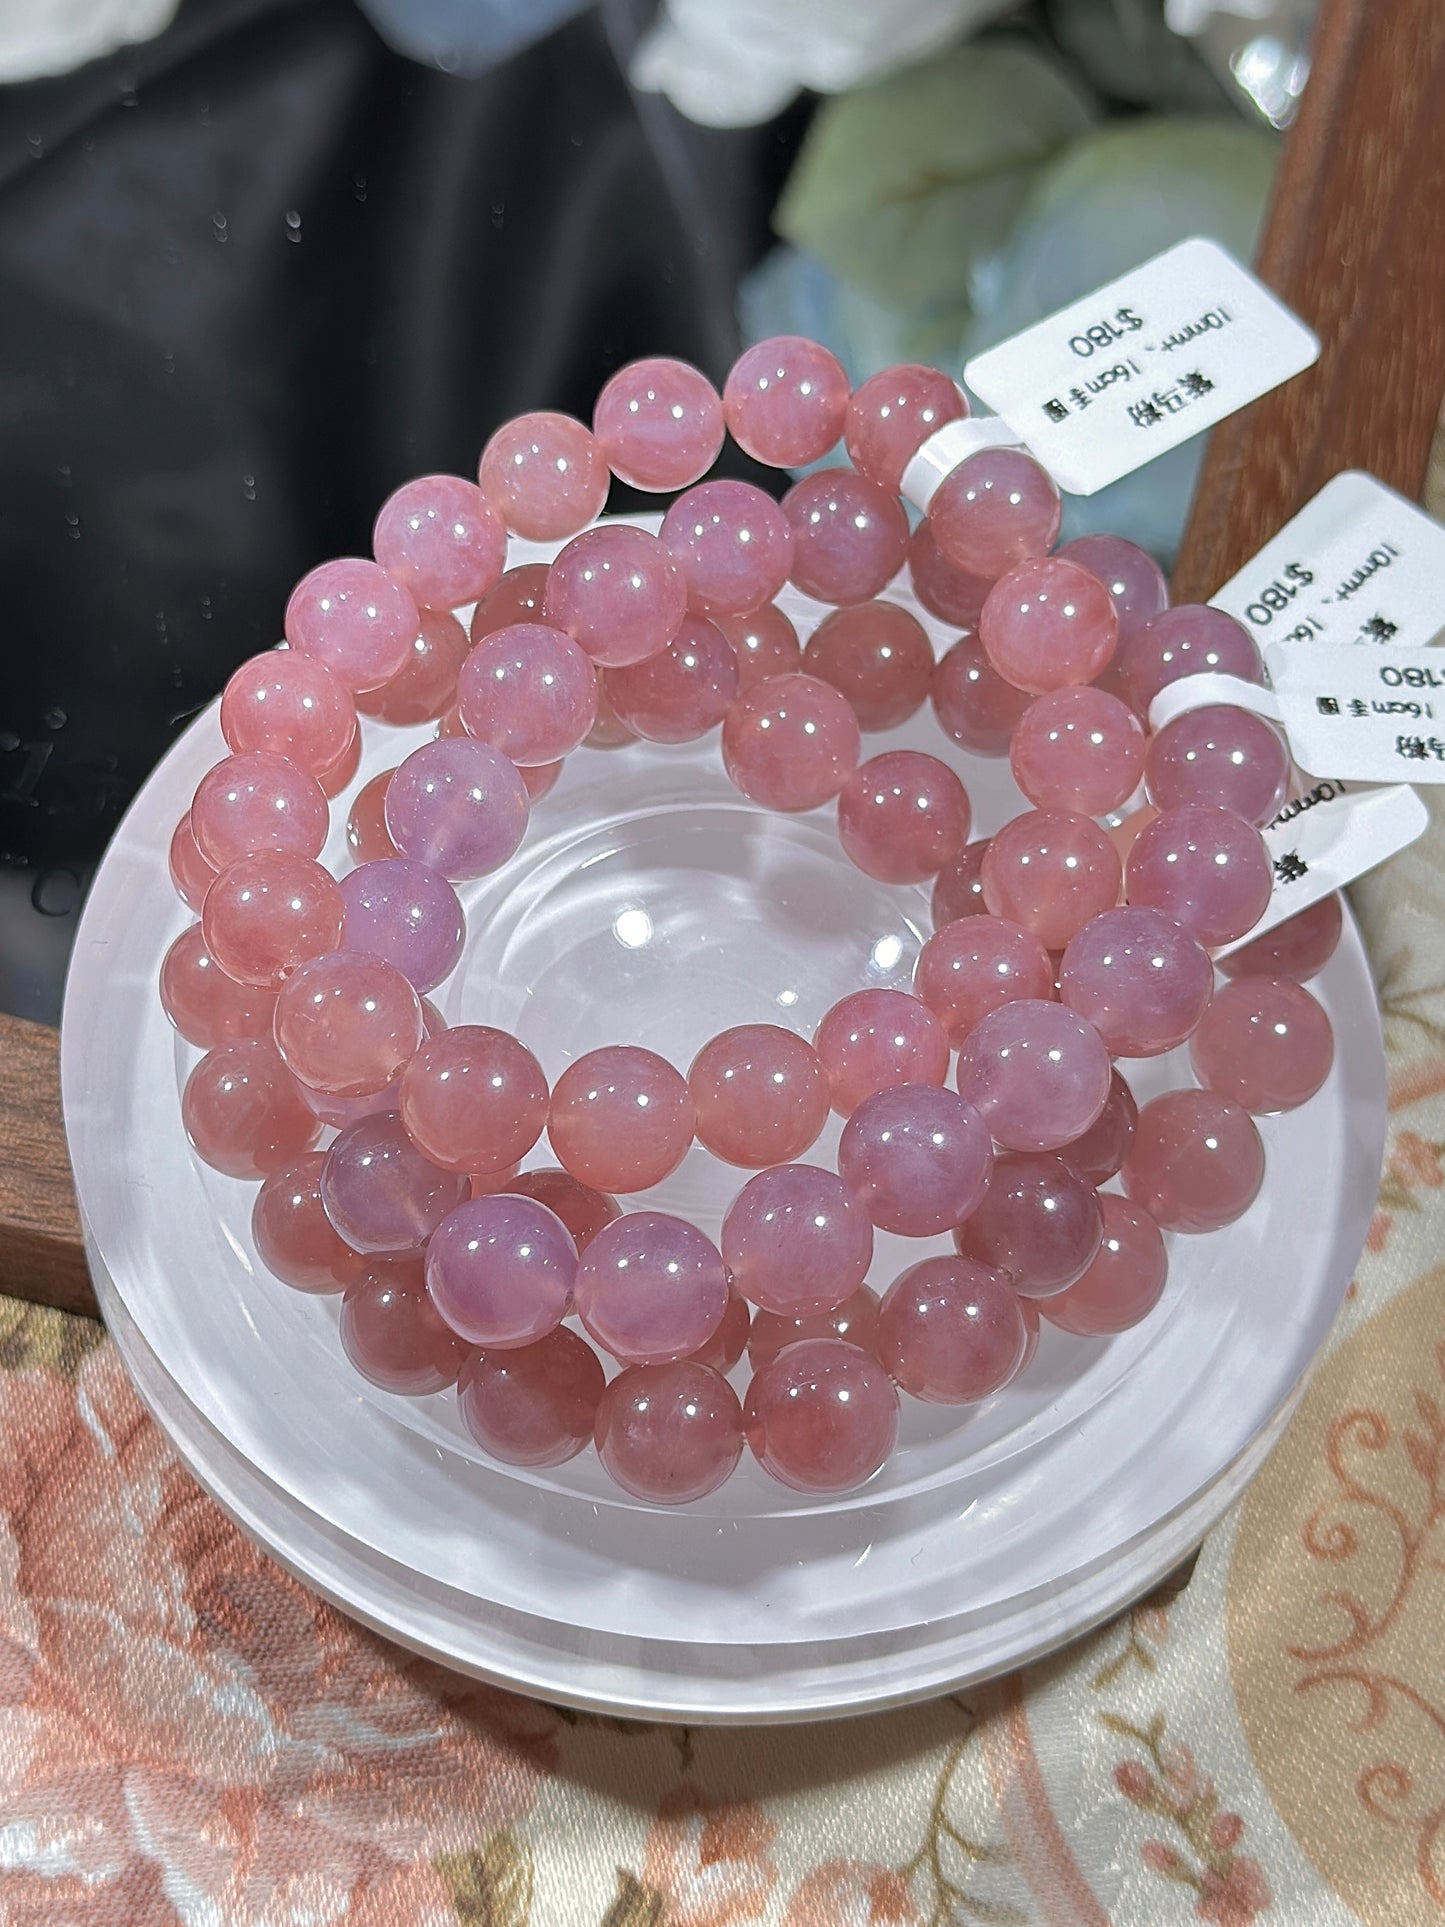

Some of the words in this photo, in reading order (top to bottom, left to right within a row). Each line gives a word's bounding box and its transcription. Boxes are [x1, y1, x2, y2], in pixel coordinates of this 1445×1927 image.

[1068, 309, 1143, 357] $180
[1246, 562, 1314, 626] $180
[1356, 612, 1398, 644] 紫
